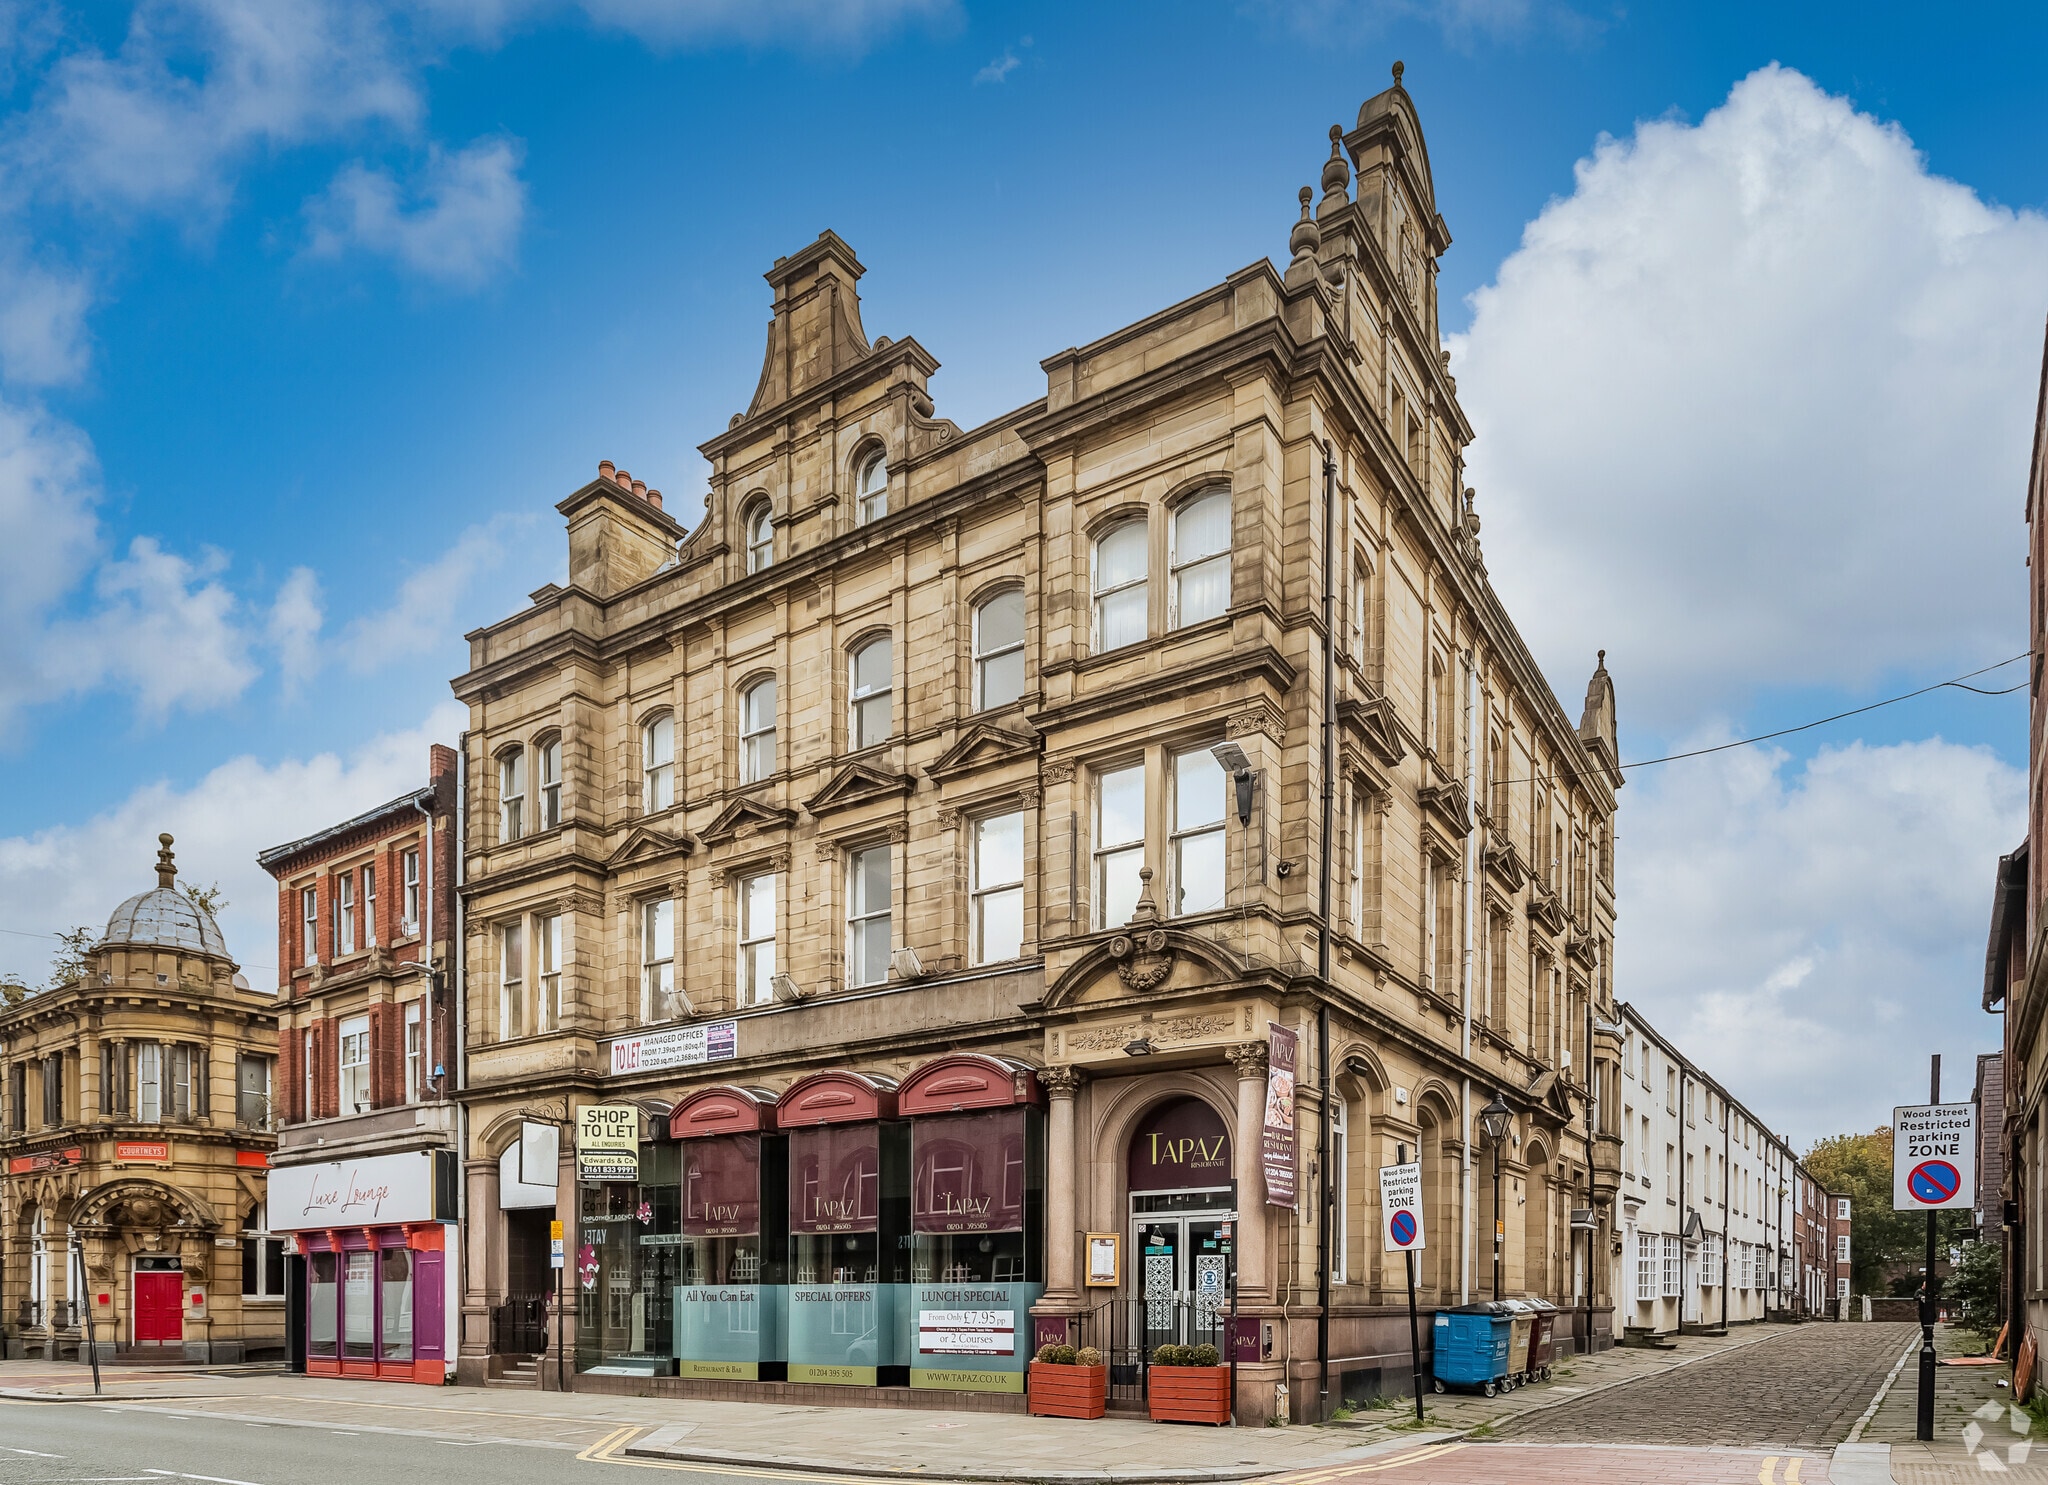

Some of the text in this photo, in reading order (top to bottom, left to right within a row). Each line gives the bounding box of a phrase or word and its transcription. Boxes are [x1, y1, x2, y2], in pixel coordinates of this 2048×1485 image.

[644, 1034, 676, 1047] MANAGED
[677, 1030, 704, 1041] OFFICES
[641, 1048, 657, 1057] FROM
[658, 1043, 682, 1054] 7.39sq.m
[1271, 1034, 1294, 1063] TAPAZ
[615, 1042, 641, 1070] TO LET
[641, 1059, 649, 1067] TO
[649, 1057, 660, 1066] 220
[660, 1056, 674, 1066] sq.m
[587, 1110, 629, 1123] SHOP
[1903, 1108, 1968, 1118] Wood Street
[1900, 1118, 1971, 1131] Restricted
[581, 1124, 635, 1138] TO LET
[1909, 1131, 1960, 1144] parking
[1145, 1132, 1226, 1165] TAPAZ
[1263, 1140, 1292, 1152] RESTAURANT
[1909, 1144, 1960, 1157] ZONE
[1190, 1160, 1225, 1168] RISTORANTE
[1399, 1167, 1417, 1175] Street
[1382, 1175, 1418, 1187] Restricted
[302, 1169, 390, 1218] Luxe Lounge
[1388, 1187, 1414, 1198] parking
[813, 1196, 854, 1217] TAPAZ
[945, 1193, 991, 1216] TAPAZ
[1389, 1196, 1415, 1208] ZONE
[703, 1202, 740, 1221] TAPAZ
[685, 1290, 754, 1302] All You Can Eat
[794, 1291, 871, 1302] SPECIAL OFFERS
[921, 1290, 1009, 1302] LUNCH SPECIAL
[928, 1311, 1006, 1326] From Only £7.95 pp
[951, 1333, 956, 1343] 2
[959, 1333, 994, 1343] Courses
[1040, 1331, 1063, 1342] TAPAZ
[1236, 1336, 1256, 1346] APAZ
[809, 1368, 853, 1378] 01204 395 505
[926, 1373, 1007, 1384] WWW.TAPAZ.CO.UK
